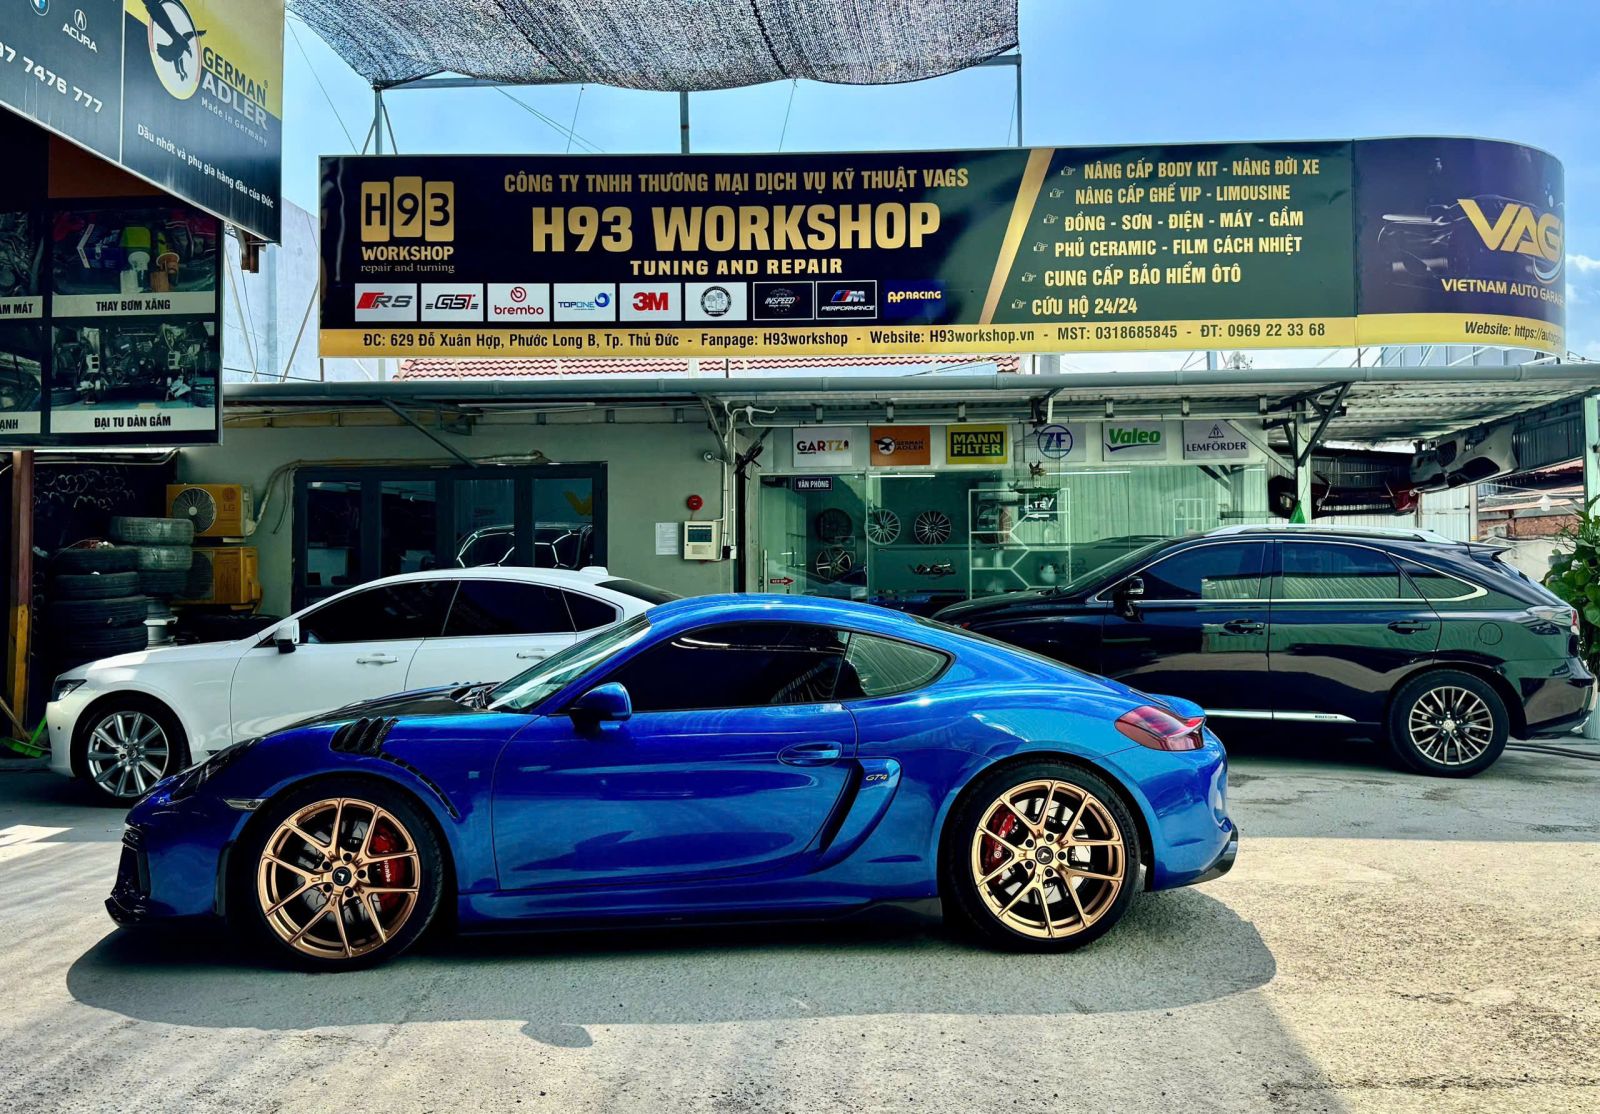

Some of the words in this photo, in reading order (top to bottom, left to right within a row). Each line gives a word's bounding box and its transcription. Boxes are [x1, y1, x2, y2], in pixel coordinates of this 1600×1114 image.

[62, 23, 98, 53] ACURA
[23, 56, 67, 95] 7476
[73, 86, 103, 113] 777
[202, 47, 266, 107] GERMAN
[202, 72, 268, 131] ADLER
[201, 97, 223, 118] Made
[224, 109, 233, 124] in
[234, 119, 268, 148] Germany
[137, 123, 155, 143] Dầu
[176, 144, 187, 160] và
[188, 150, 202, 172] phụ
[204, 163, 215, 179] gia
[216, 168, 234, 190] hàng
[1084, 161, 1122, 180] NÂNG
[1126, 157, 1153, 179] CẤP
[1158, 162, 1193, 177] BODY
[1197, 161, 1218, 177] KIT
[1232, 159, 1270, 176] NÂNG
[1275, 158, 1298, 175] ĐỜI
[1303, 159, 1320, 174] XE
[504, 170, 553, 193] CÔNG
[559, 173, 581, 192] TY
[586, 173, 632, 192] TNHH
[639, 172, 708, 192] THƯƠNG
[715, 172, 748, 195] MẠI
[756, 171, 797, 195] DỊCH
[803, 171, 826, 194] VỤ
[832, 167, 854, 190] KỸ
[861, 166, 918, 193] THUẬT
[923, 168, 969, 188] VAGS
[1075, 187, 1113, 204] NÂNG
[1117, 182, 1144, 204] CẤP
[1149, 181, 1176, 203] GHẾ
[1180, 187, 1202, 202] VIP
[1216, 184, 1290, 201] LIMOUSINE
[365, 193, 450, 227] H93
[1065, 210, 1105, 231] ĐỒNG
[1121, 213, 1153, 230] SƠN
[1168, 210, 1204, 232] ĐIỆN
[1219, 209, 1253, 227] MÁY
[1269, 206, 1304, 227] GẦM
[532, 206, 633, 253] H93
[651, 202, 941, 252] WORKSHOP
[362, 246, 454, 262] WORKSHOP
[1055, 237, 1084, 258] PHỦ
[1090, 239, 1156, 257] CERAMIC
[1172, 239, 1208, 255] FILM
[1213, 235, 1253, 254] CÁCH
[1258, 234, 1302, 256] NHIỆT
[361, 263, 392, 274] repair
[394, 262, 414, 273] and
[416, 262, 455, 274] turning
[630, 260, 708, 276] TUNING
[716, 260, 758, 275] AND
[767, 258, 842, 274] REPAIR
[1044, 270, 1087, 286] CUNG
[1092, 263, 1124, 286] CẤP
[1129, 262, 1161, 285] BẢO
[1166, 260, 1206, 284] HIỂM
[1211, 262, 1241, 283] ÔTÔ
[906, 290, 942, 300] RACING
[1441, 278, 1507, 295] VIETNAM
[1509, 283, 1539, 299] AUTO
[13, 301, 34, 314] MÁT
[96, 300, 118, 312] THAY
[121, 298, 142, 311] BƠM
[145, 297, 171, 310] XĂNG
[494, 305, 544, 315] brembo
[632, 292, 669, 311] 3M
[820, 304, 875, 312] PERFORMANCE
[1032, 297, 1063, 315] CỨU
[1068, 294, 1089, 318] HỘ
[1094, 297, 1138, 315] 24/24
[363, 333, 386, 347] ĐC:
[390, 333, 414, 347] 629
[418, 331, 436, 347] Đỗ
[440, 333, 471, 347] Xuân
[476, 333, 504, 349] Hợp,
[509, 332, 548, 347] Phước
[552, 332, 583, 349] Long
[587, 333, 600, 348] B,
[604, 333, 623, 349] Tp.
[628, 331, 651, 346] Thủ
[655, 332, 680, 346] Đức
[701, 333, 758, 349] Fanpage:
[763, 332, 848, 349] H93workshop
[870, 330, 925, 344] Website:
[929, 327, 1035, 346] H93workshop.vn
[1057, 326, 1091, 340] MST:
[1095, 325, 1178, 340] 0318685845
[1200, 324, 1223, 338] ĐT:
[1227, 324, 1261, 338] 0969
[1265, 323, 1282, 337] 22
[1287, 323, 1304, 336] 33
[1308, 322, 1326, 336] 68
[1465, 321, 1511, 336] Website:
[94, 417, 110, 431] ĐẠI
[113, 417, 126, 427] TU
[127, 414, 147, 427] DÀN
[953, 433, 1000, 443] MANN
[1108, 427, 1161, 444] Valeo
[953, 444, 1000, 454] FILTER
[1186, 440, 1247, 453] LEMFÖRDER
[223, 503, 235, 512] LG
